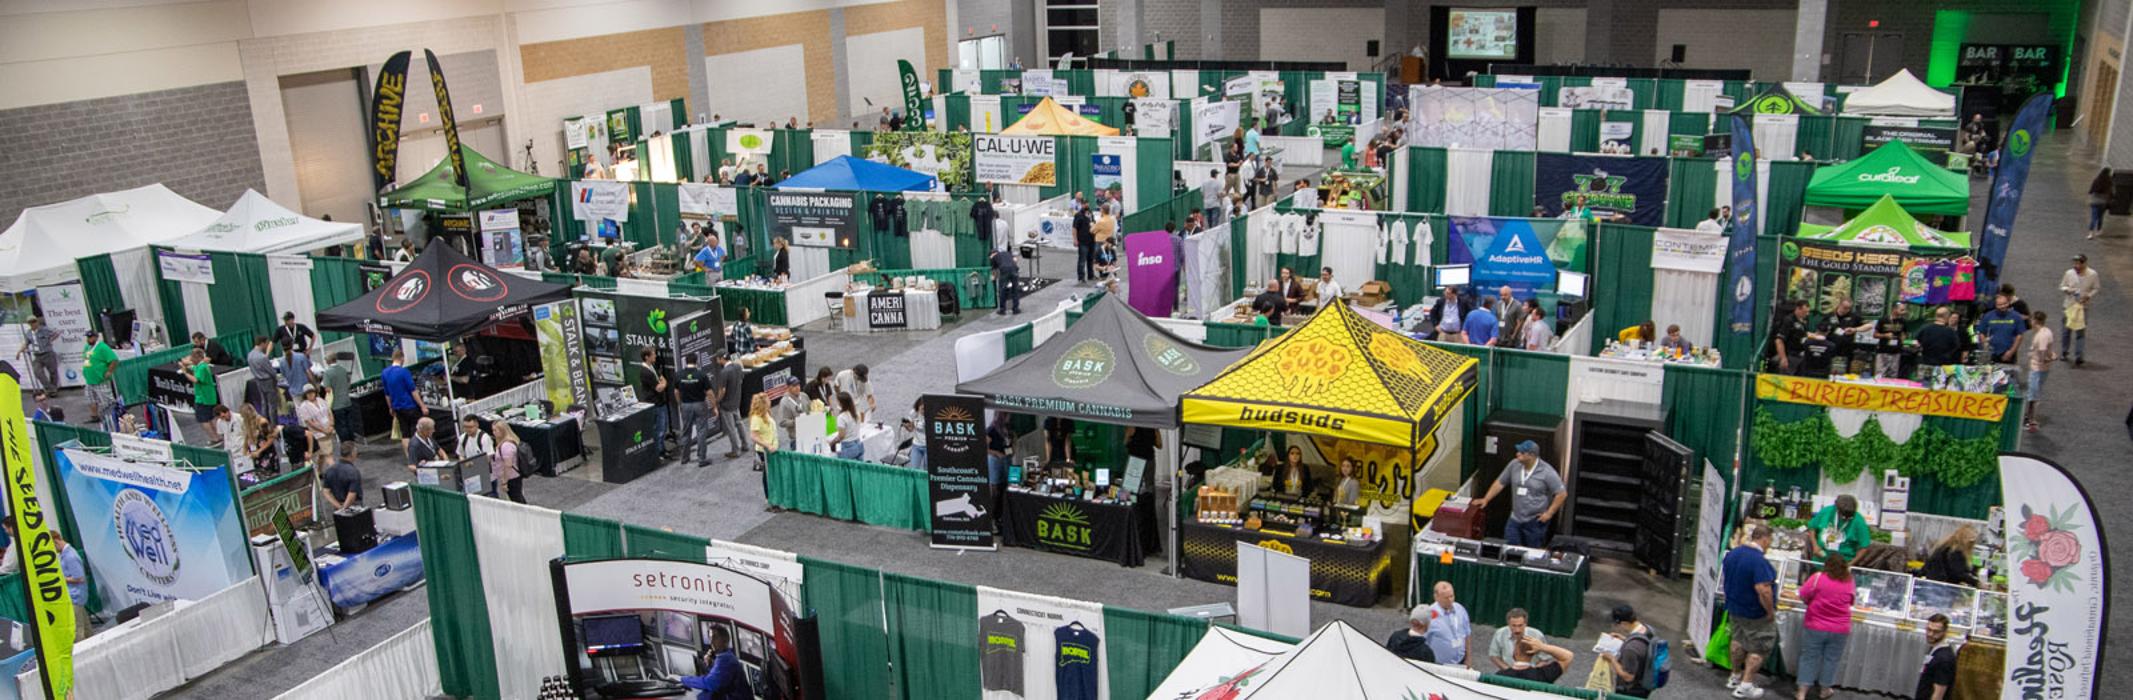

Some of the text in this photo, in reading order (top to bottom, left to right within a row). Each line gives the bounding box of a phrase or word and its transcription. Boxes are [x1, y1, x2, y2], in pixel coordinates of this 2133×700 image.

[1966, 46, 1998, 59] BAR
[2014, 47, 2047, 60] BAR
[904, 73, 922, 127] 253
[376, 71, 404, 180] ARCHIVE
[1858, 170, 1920, 184] curaleaf
[770, 195, 853, 209] CANNABIS PACKAGING
[1137, 252, 1163, 266] insa
[1488, 254, 1544, 265] AdaptiveHR
[1801, 247, 1854, 262] SEEDS
[1856, 251, 1900, 264] HERE
[1801, 256, 1901, 275] THE GOLD STANDAR
[871, 297, 903, 309] AMERI
[46, 307, 82, 317] The best
[871, 312, 905, 324] CANNA
[58, 318, 77, 326] cure
[67, 327, 87, 337] your
[564, 319, 579, 356] STALK
[61, 335, 83, 344] buds
[625, 333, 656, 347] STALK
[658, 337, 667, 348] &
[570, 359, 581, 368] &
[1157, 346, 1182, 367] BASK
[1062, 359, 1105, 372] BASK
[994, 393, 1133, 419] BASK PREMIUM CANNABIS
[1789, 381, 2008, 419] BURIED TREASURES
[1239, 406, 1346, 431] budsuds
[934, 421, 976, 436] BASK
[6, 417, 23, 462] THE
[79, 462, 185, 493] www.medwellhealth.net
[937, 466, 979, 475] Southcoast's
[929, 474, 988, 484] Premier Cannabis
[940, 483, 978, 492] Dispensary
[15, 466, 44, 531] SEED
[1037, 520, 1092, 545] BASK
[633, 571, 734, 598] setronics
